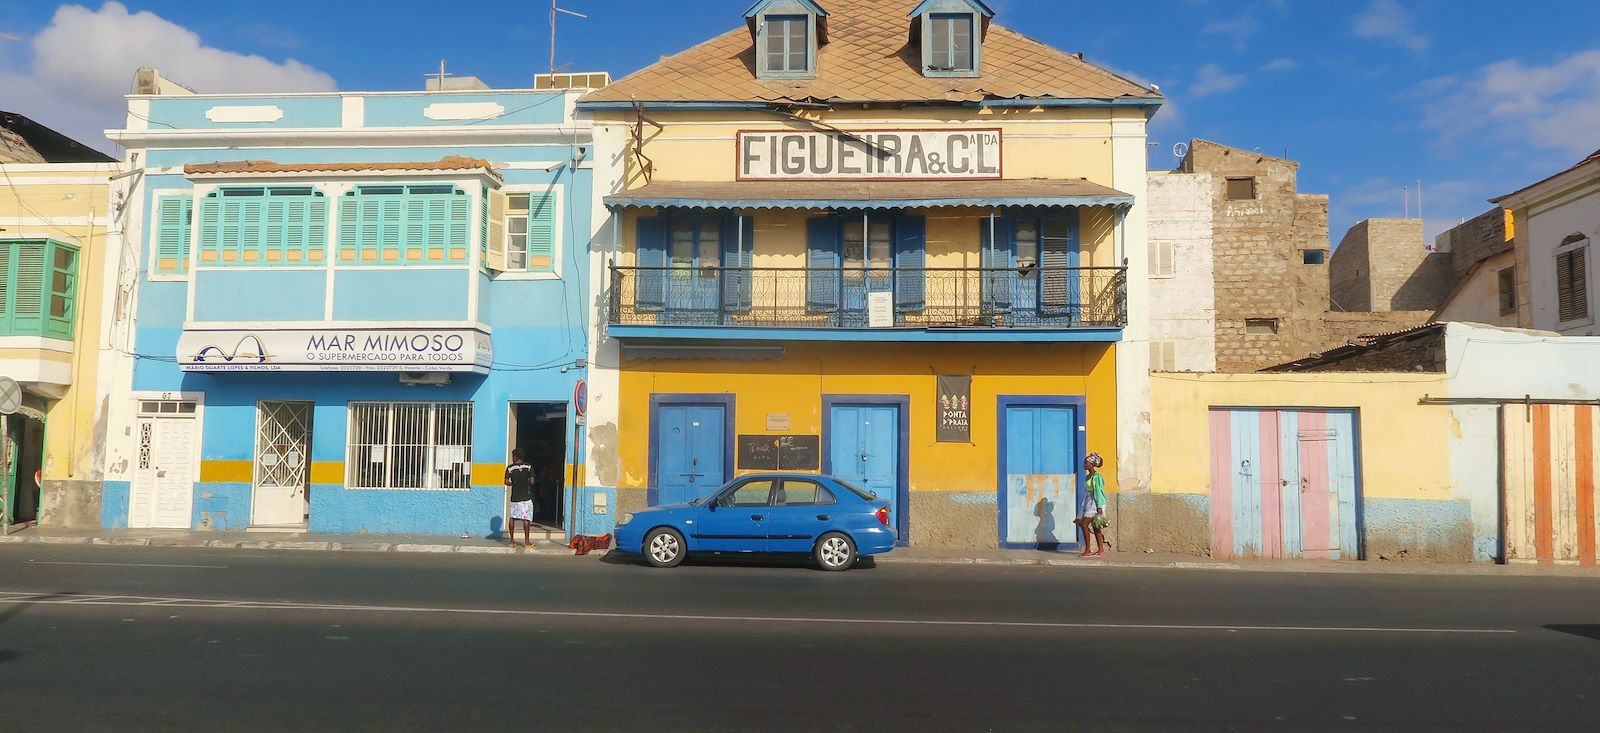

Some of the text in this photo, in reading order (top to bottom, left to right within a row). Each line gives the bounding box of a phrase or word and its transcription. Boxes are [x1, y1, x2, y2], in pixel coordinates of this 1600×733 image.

[743, 135, 928, 174] FIGUEIRA
[307, 334, 463, 351] MAR MIMOSO
[306, 352, 464, 361] O SUPERMERCADO PARA TODOS
[943, 410, 967, 419] PONTA
